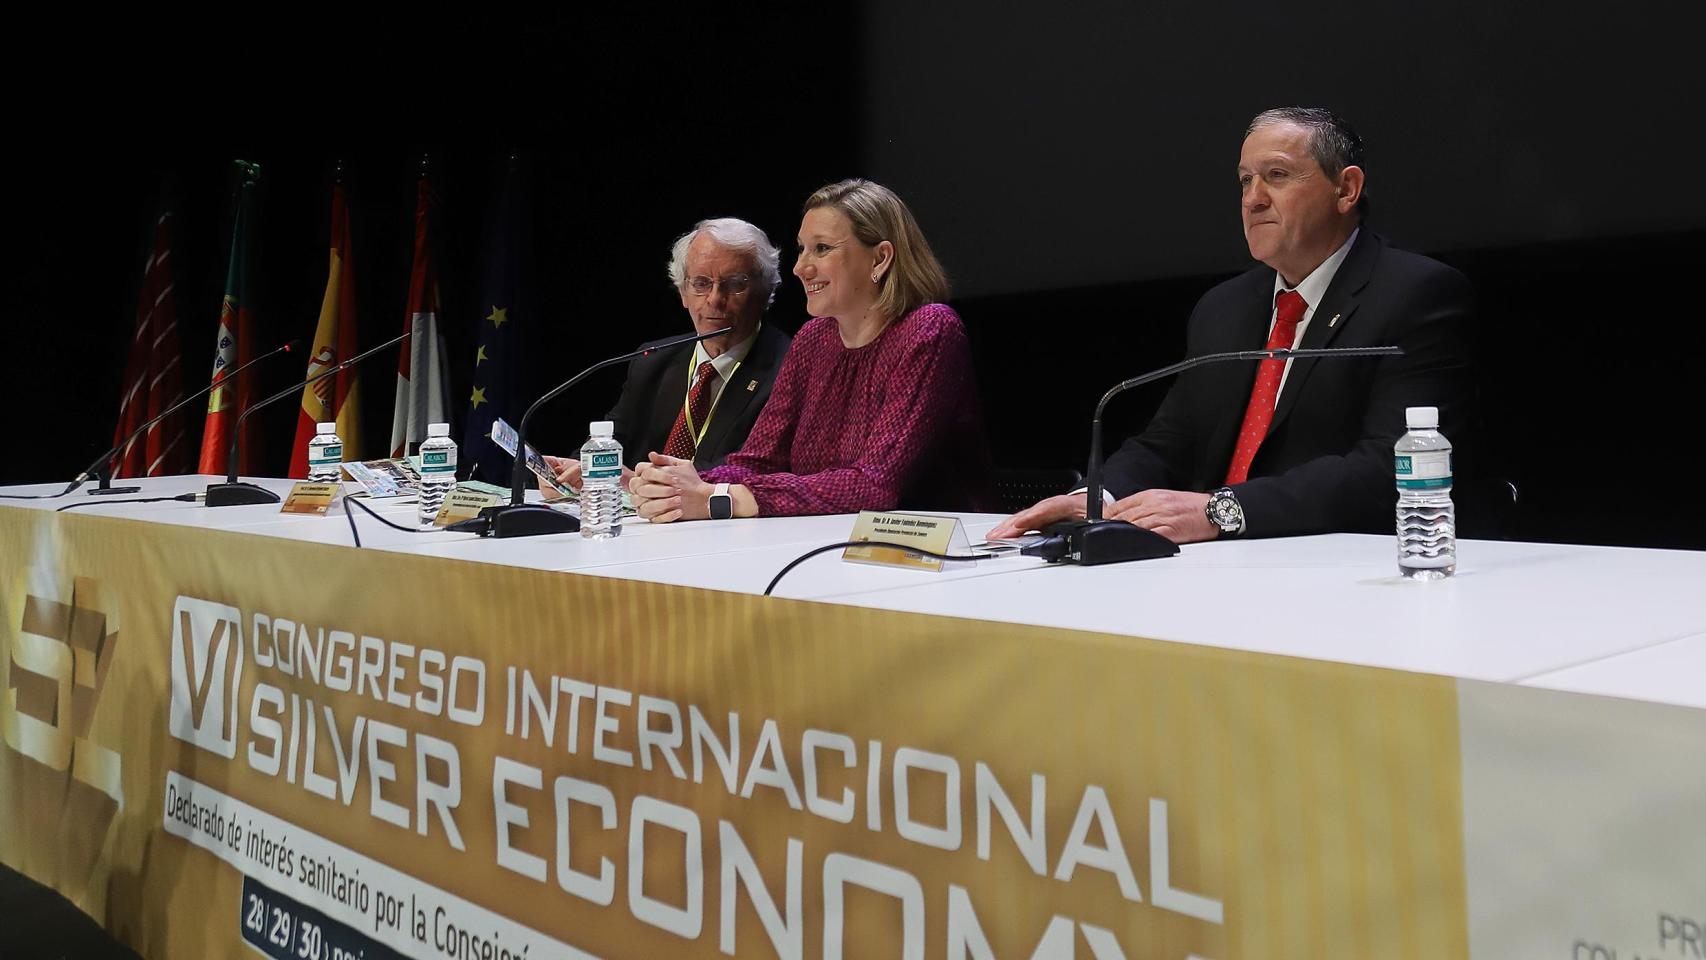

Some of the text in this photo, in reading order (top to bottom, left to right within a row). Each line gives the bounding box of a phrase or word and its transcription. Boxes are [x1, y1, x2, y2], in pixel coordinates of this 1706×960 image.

[180, 610, 240, 744] VI
[252, 612, 1224, 925] CONGRESO INTERNACIONAL
[167, 783, 225, 842] Declarado
[227, 812, 242, 853] de
[246, 819, 294, 877] interés
[298, 854, 369, 914] sanitario
[375, 889, 404, 932] por
[411, 893, 427, 944] la
[248, 683, 1218, 960] SILVER ECONO
